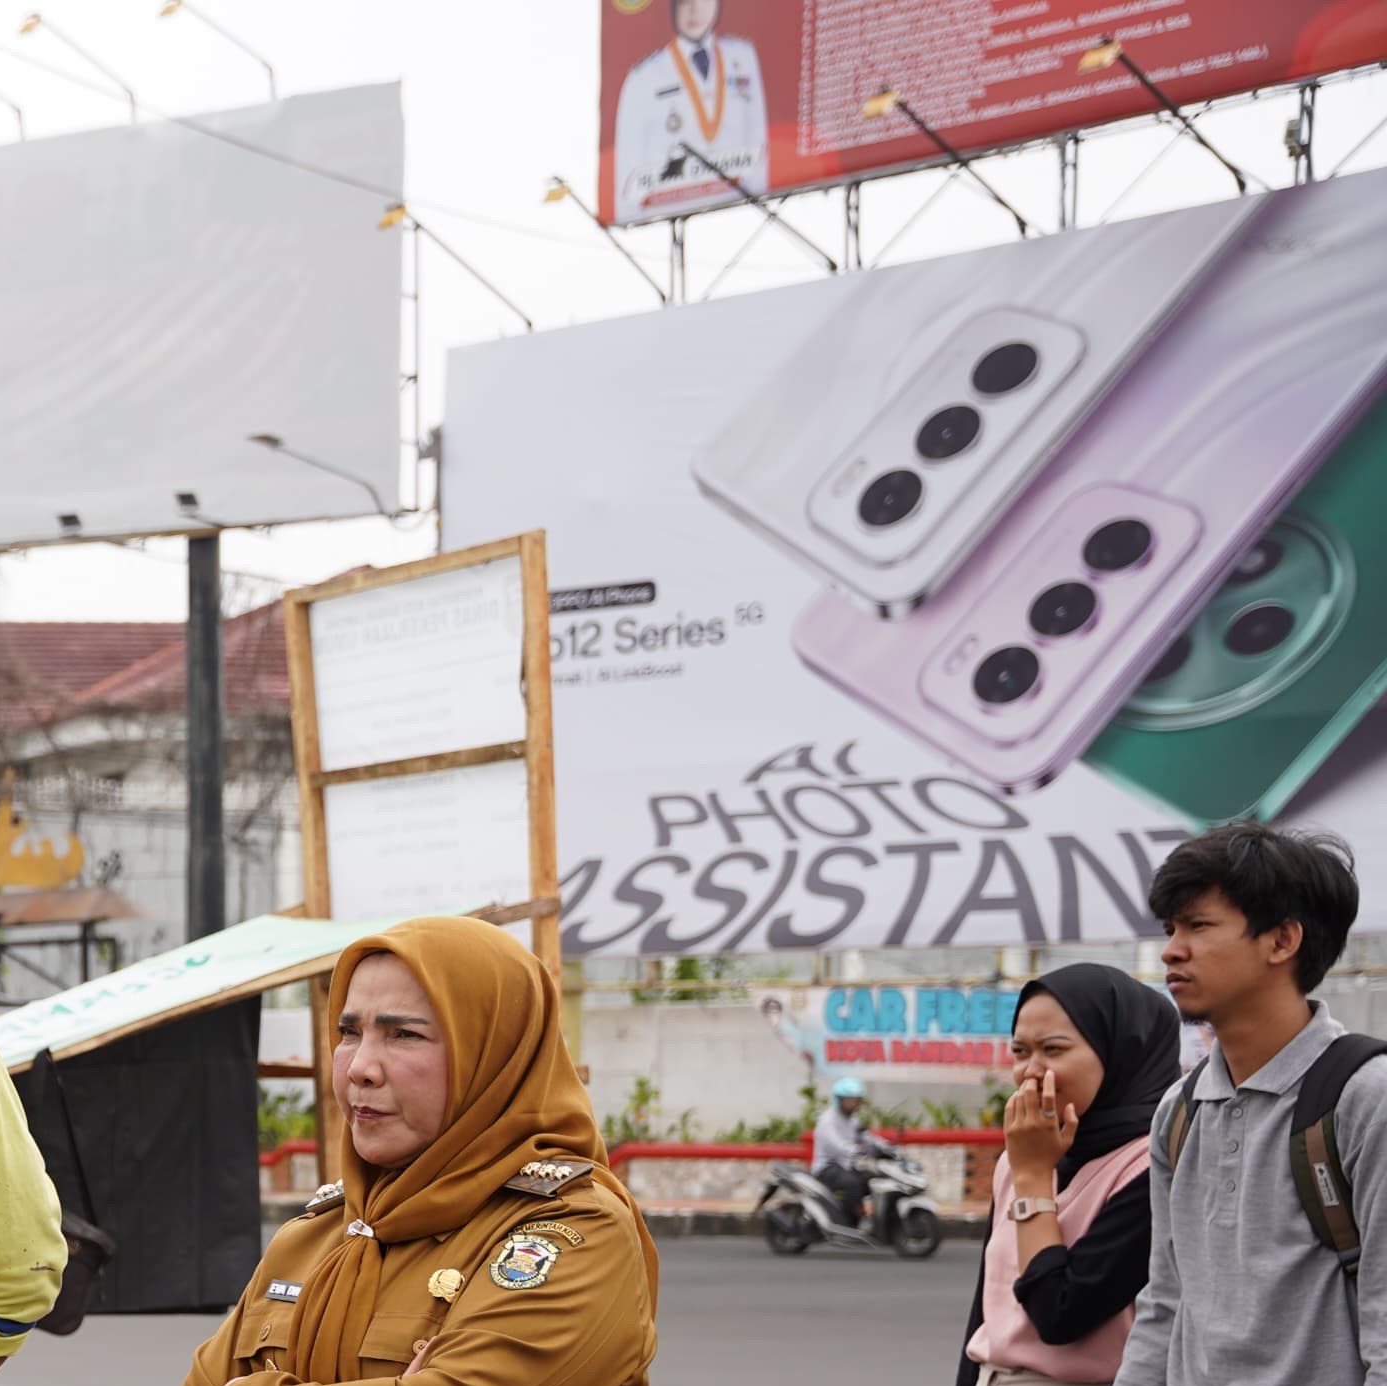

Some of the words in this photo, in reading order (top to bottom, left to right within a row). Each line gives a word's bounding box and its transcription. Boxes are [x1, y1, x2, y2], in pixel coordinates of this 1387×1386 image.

[550, 619, 602, 660] o12
[613, 611, 726, 654] Series
[647, 776, 1030, 847] PHOTO
[824, 986, 907, 1034] CAR
